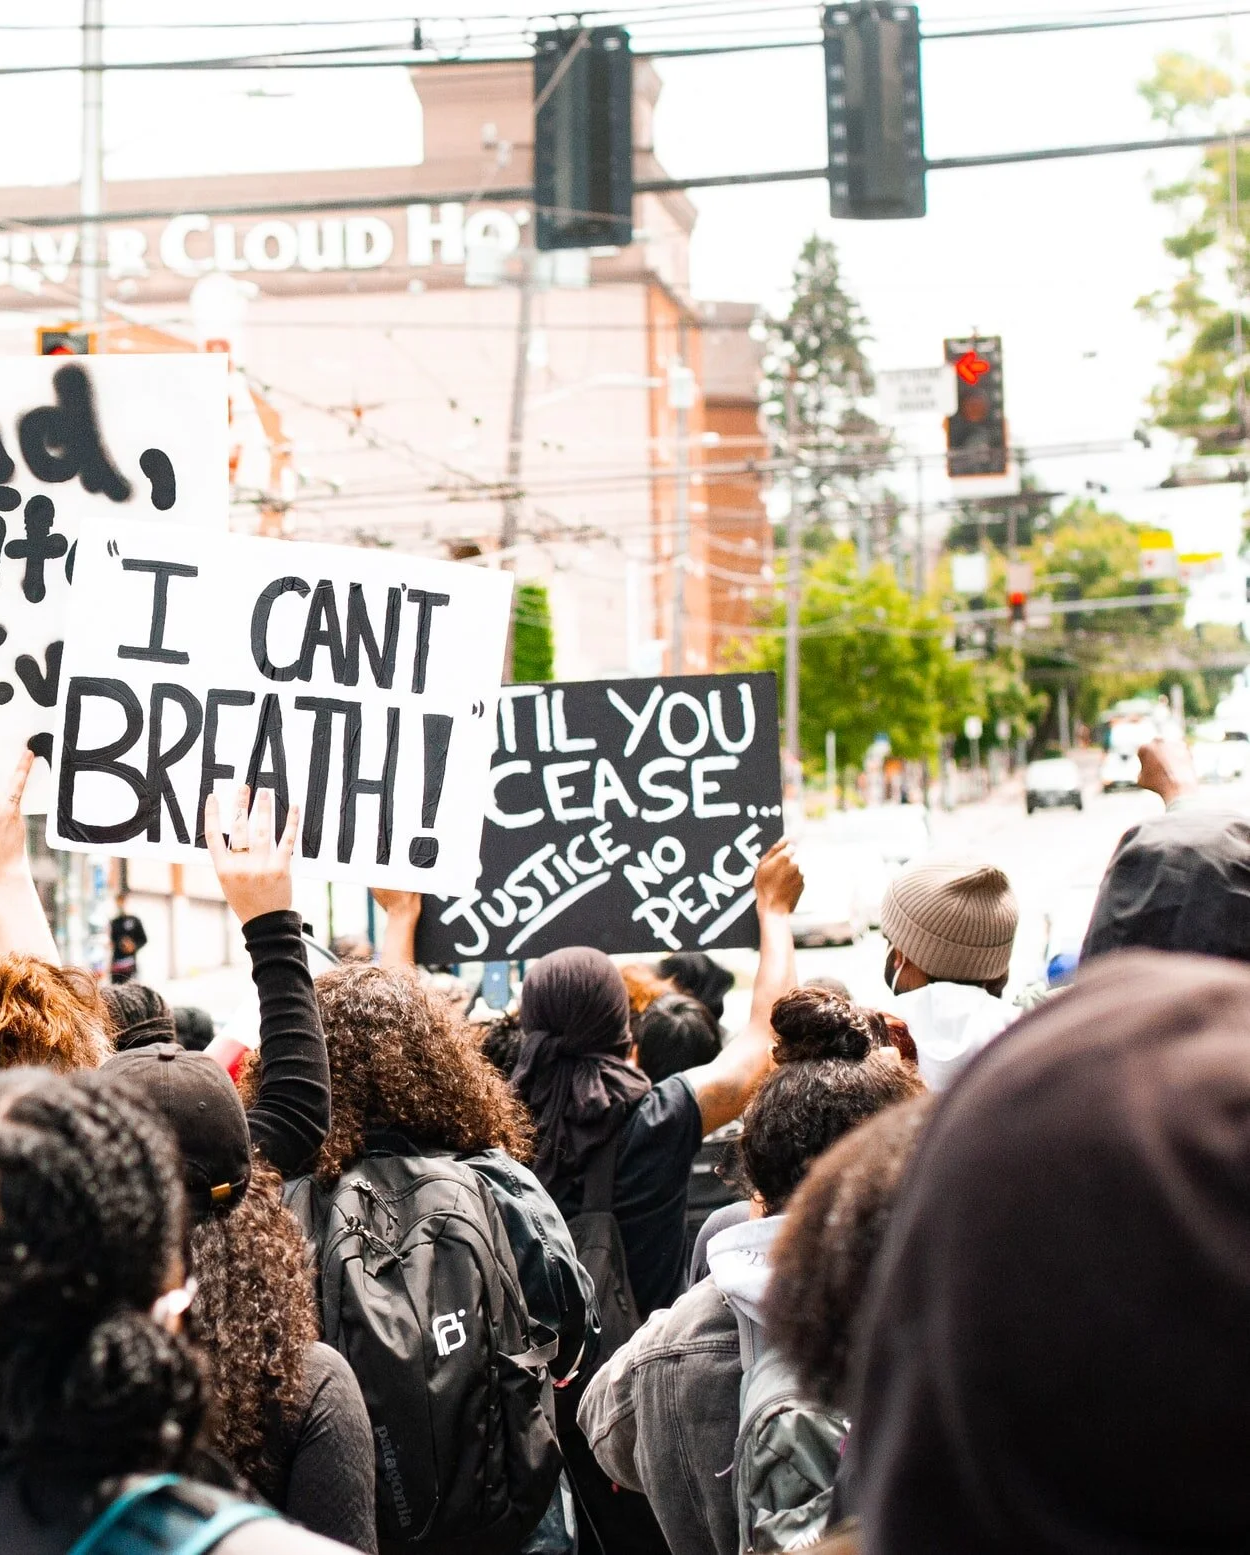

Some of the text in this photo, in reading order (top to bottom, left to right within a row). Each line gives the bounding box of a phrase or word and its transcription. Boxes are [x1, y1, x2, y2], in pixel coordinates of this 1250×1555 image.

[159, 213, 394, 277] CLOUD
[407, 202, 530, 265] HO
[250, 576, 450, 694] CAN'T
[606, 682, 756, 757] YOU
[484, 755, 782, 829] CEASE...
[439, 821, 631, 956] JUSTICE
[623, 836, 686, 899] NO
[374, 1424, 413, 1529] patagonia
